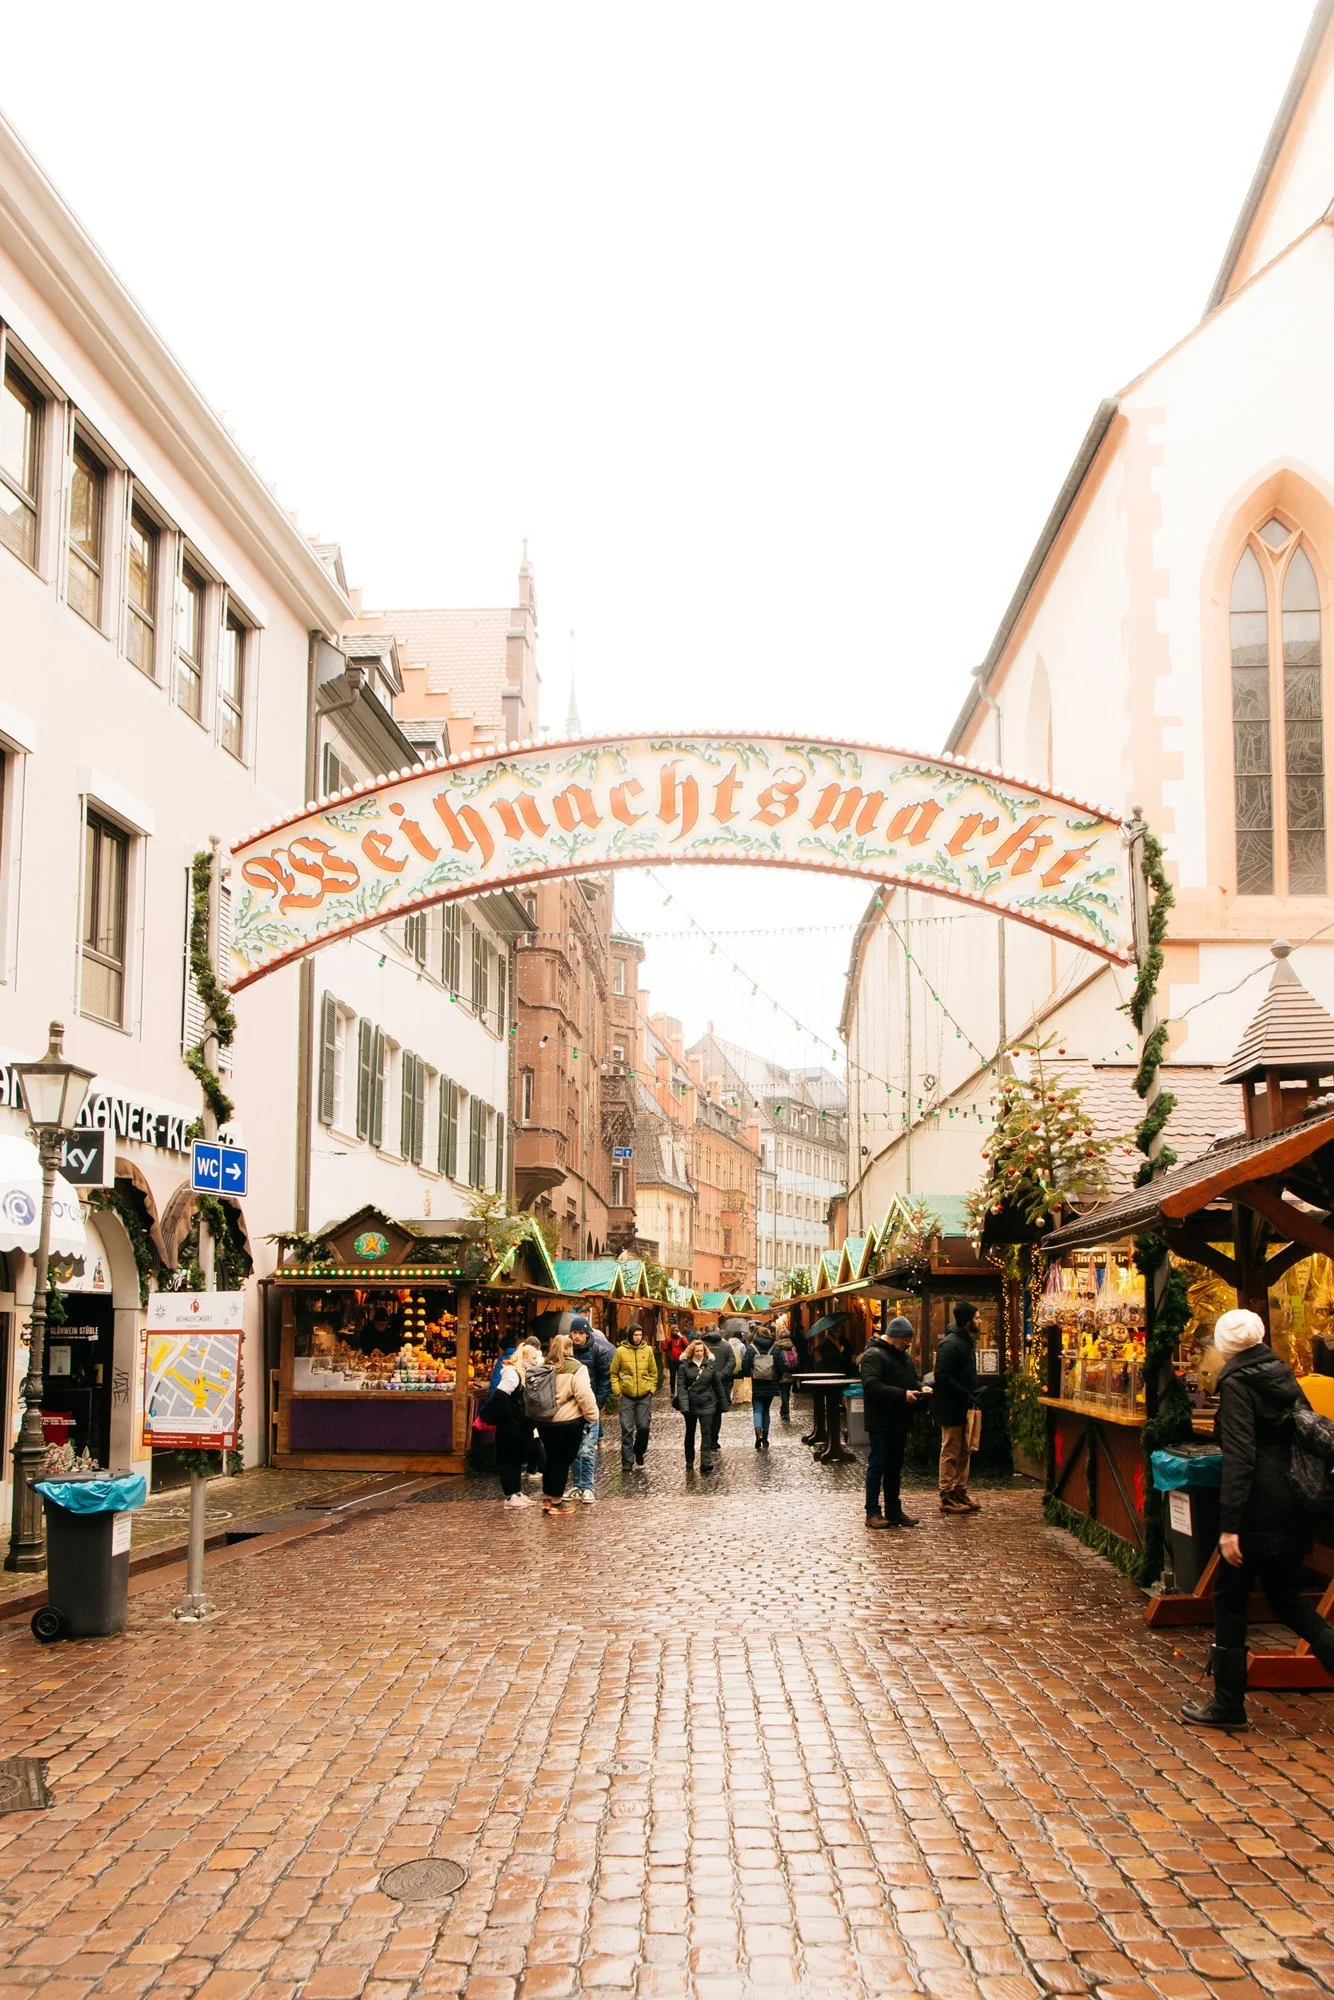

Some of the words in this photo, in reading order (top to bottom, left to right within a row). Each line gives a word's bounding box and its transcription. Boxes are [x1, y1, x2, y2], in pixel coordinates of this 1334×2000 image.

[241, 758, 1101, 916] Weihnachtsmarkt
[60, 1140, 98, 1175] ky
[197, 1156, 219, 1178] WC
